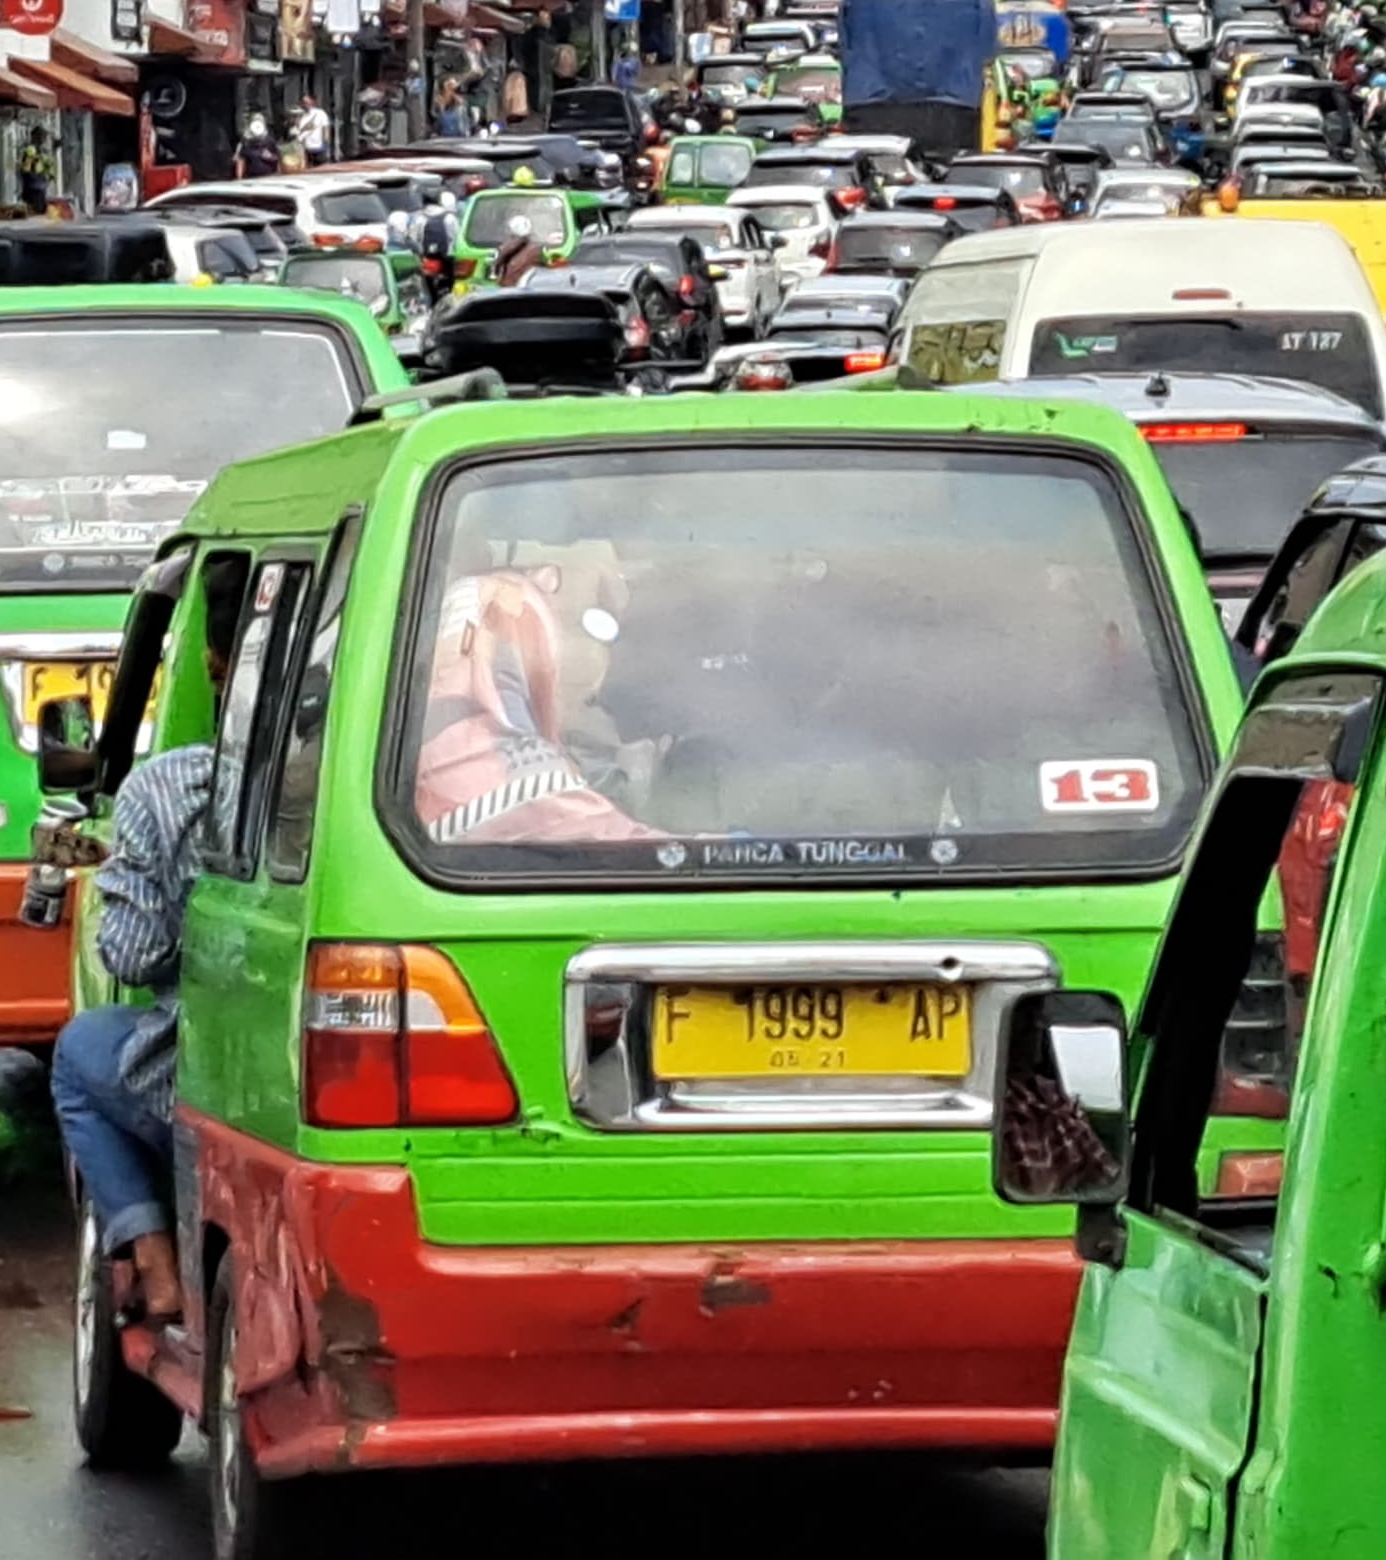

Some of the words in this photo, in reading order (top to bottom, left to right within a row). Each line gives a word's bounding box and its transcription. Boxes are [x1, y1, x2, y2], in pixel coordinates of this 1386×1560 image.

[1048, 769, 1152, 803] 13
[703, 841, 785, 865] PANCA
[798, 840, 907, 864] TUNGGAL
[665, 990, 692, 1044] F
[737, 987, 845, 1043] 1999
[910, 989, 962, 1043] AP
